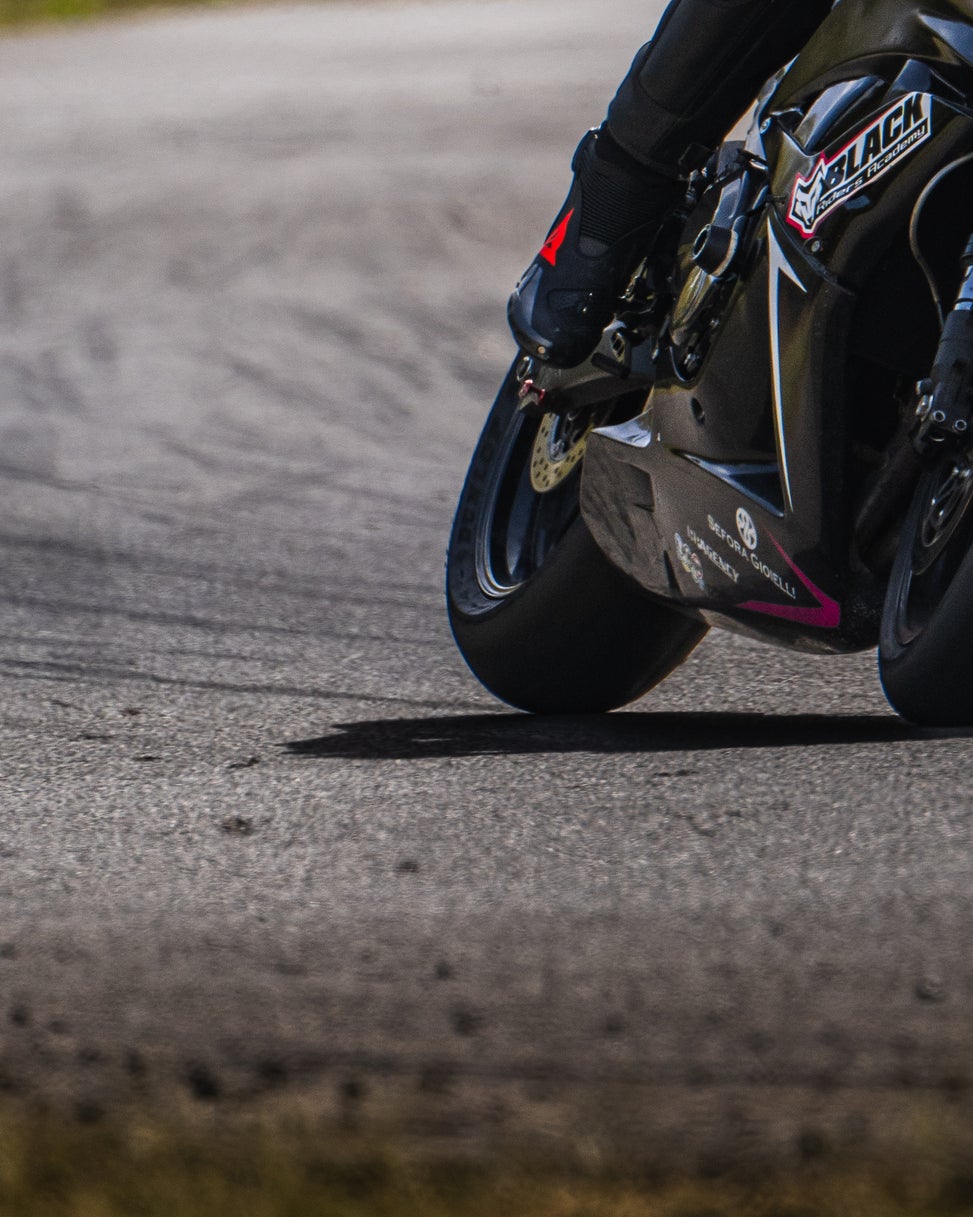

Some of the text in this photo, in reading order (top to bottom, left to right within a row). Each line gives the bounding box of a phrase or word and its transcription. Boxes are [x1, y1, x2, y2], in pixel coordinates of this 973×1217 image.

[816, 125, 926, 215] Riders Academy
[825, 93, 923, 189] BLACK
